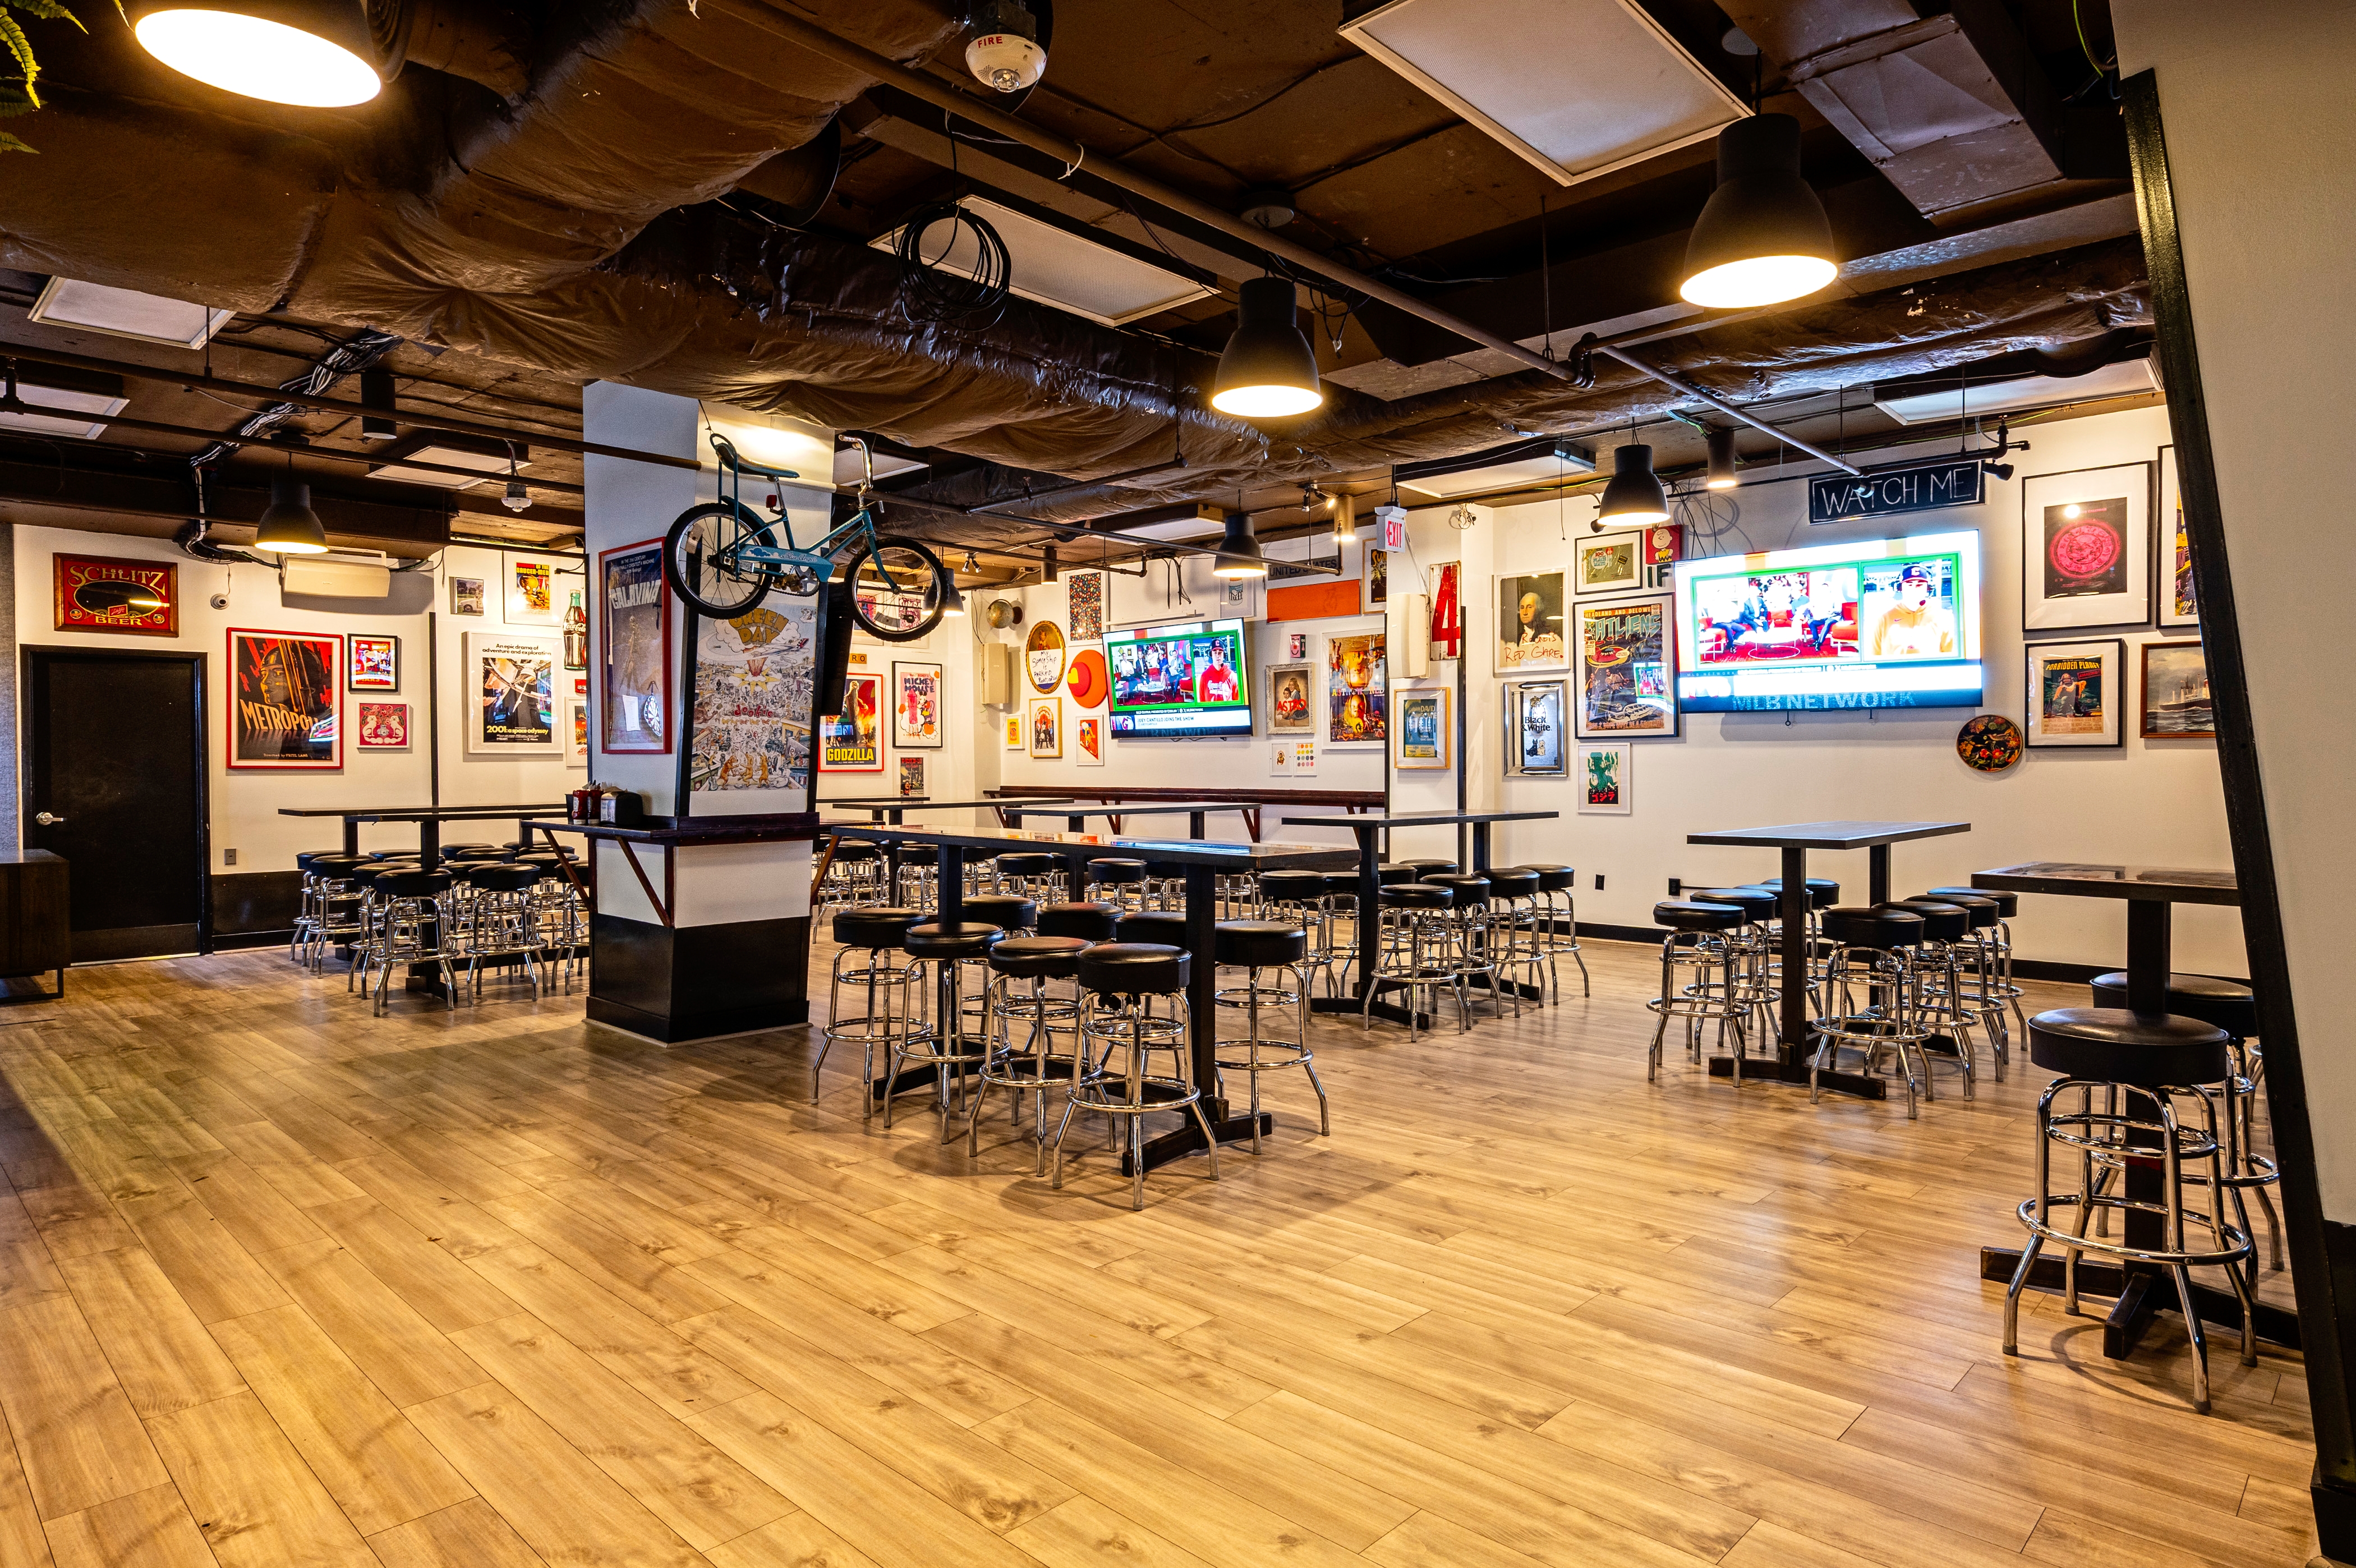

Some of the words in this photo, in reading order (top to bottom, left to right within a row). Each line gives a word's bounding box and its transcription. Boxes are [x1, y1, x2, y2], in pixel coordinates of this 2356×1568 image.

[978, 36, 1003, 48] FIRE
[1930, 467, 1972, 503] ME
[1387, 520, 1402, 548] EXIT
[68, 565, 165, 596] SCHLITZ
[1647, 563, 1671, 588] IF
[609, 579, 661, 609] GALAXINA
[1432, 564, 1461, 657] 4
[95, 615, 142, 626] BEER
[729, 608, 789, 632] GREEN
[1595, 614, 1661, 641] ATLIENS
[738, 626, 780, 643] DAY
[2045, 661, 2078, 670] FORBIDDEN
[2078, 661, 2100, 669] PLANET
[904, 677, 935, 686] MICKEY
[1277, 698, 1307, 712] ASTRO
[1787, 691, 1916, 709] NETWORK
[734, 704, 774, 718] dookie
[827, 748, 875, 761] GODZILLA
[1591, 792, 1615, 802] ゴジラ
